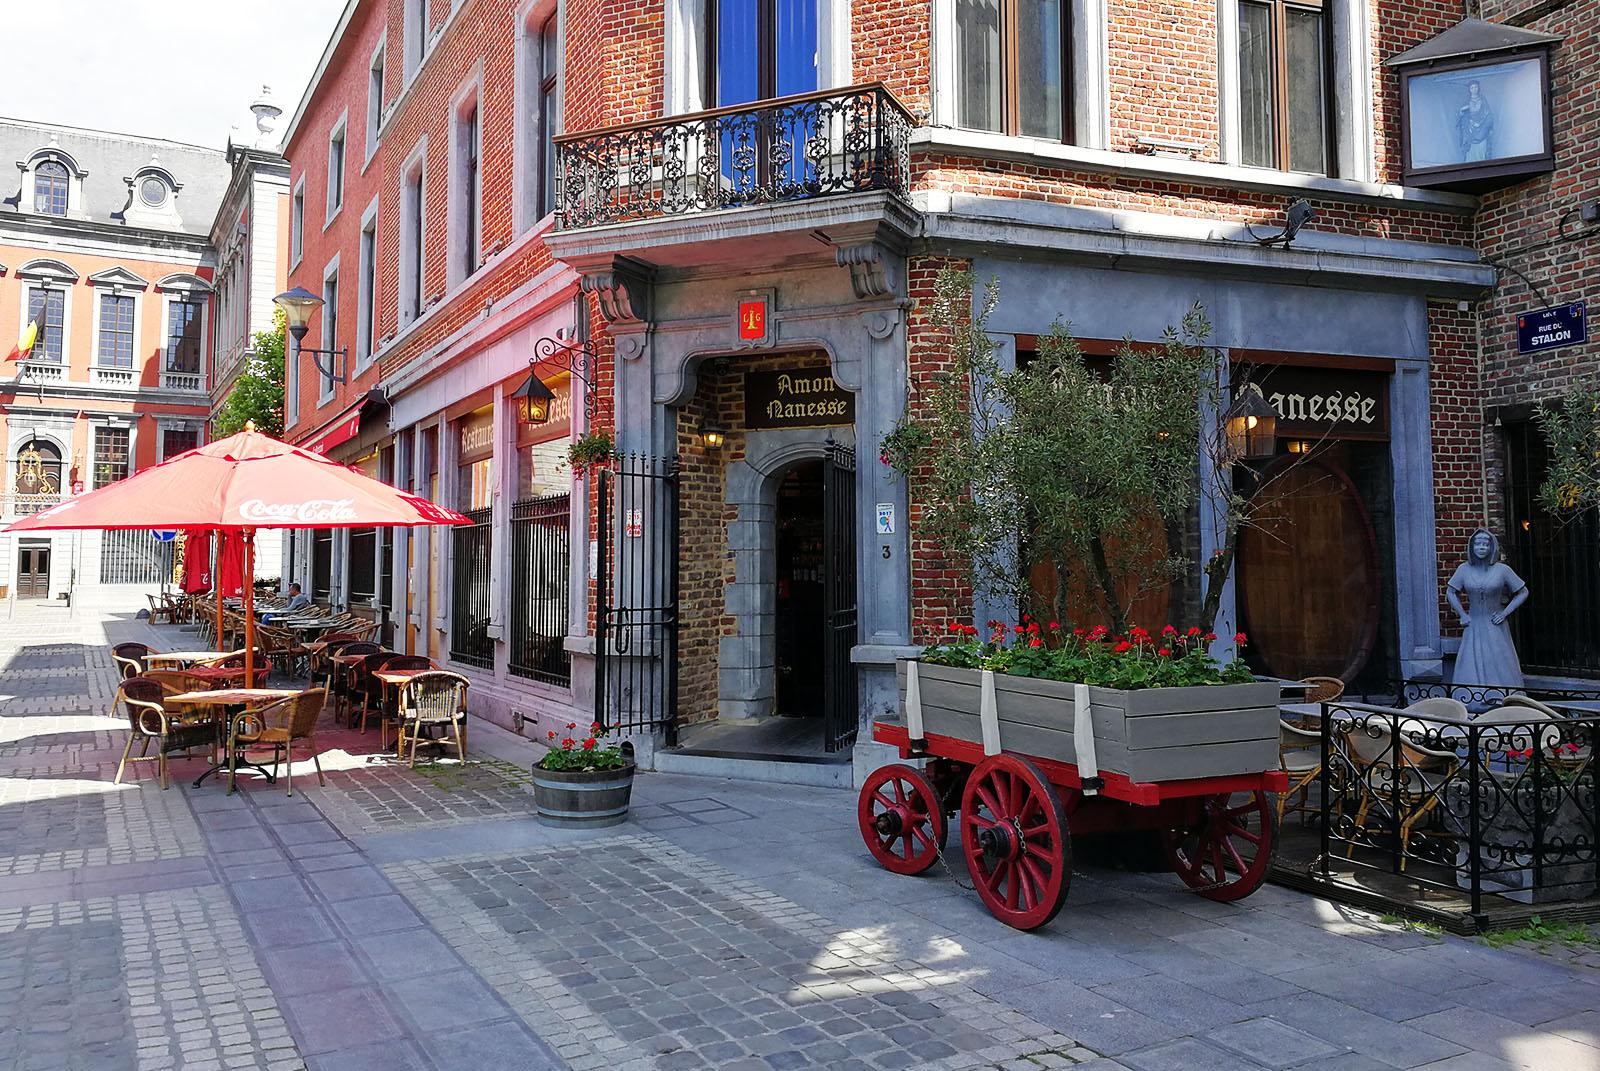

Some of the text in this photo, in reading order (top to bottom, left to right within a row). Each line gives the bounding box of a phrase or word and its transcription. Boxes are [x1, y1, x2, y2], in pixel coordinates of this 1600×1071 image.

[1538, 324, 1552, 333] RUE
[1531, 330, 1571, 346] STALON
[777, 374, 835, 396] Amon
[239, 498, 359, 522] Coca-Cola
[882, 544, 891, 560] 3
